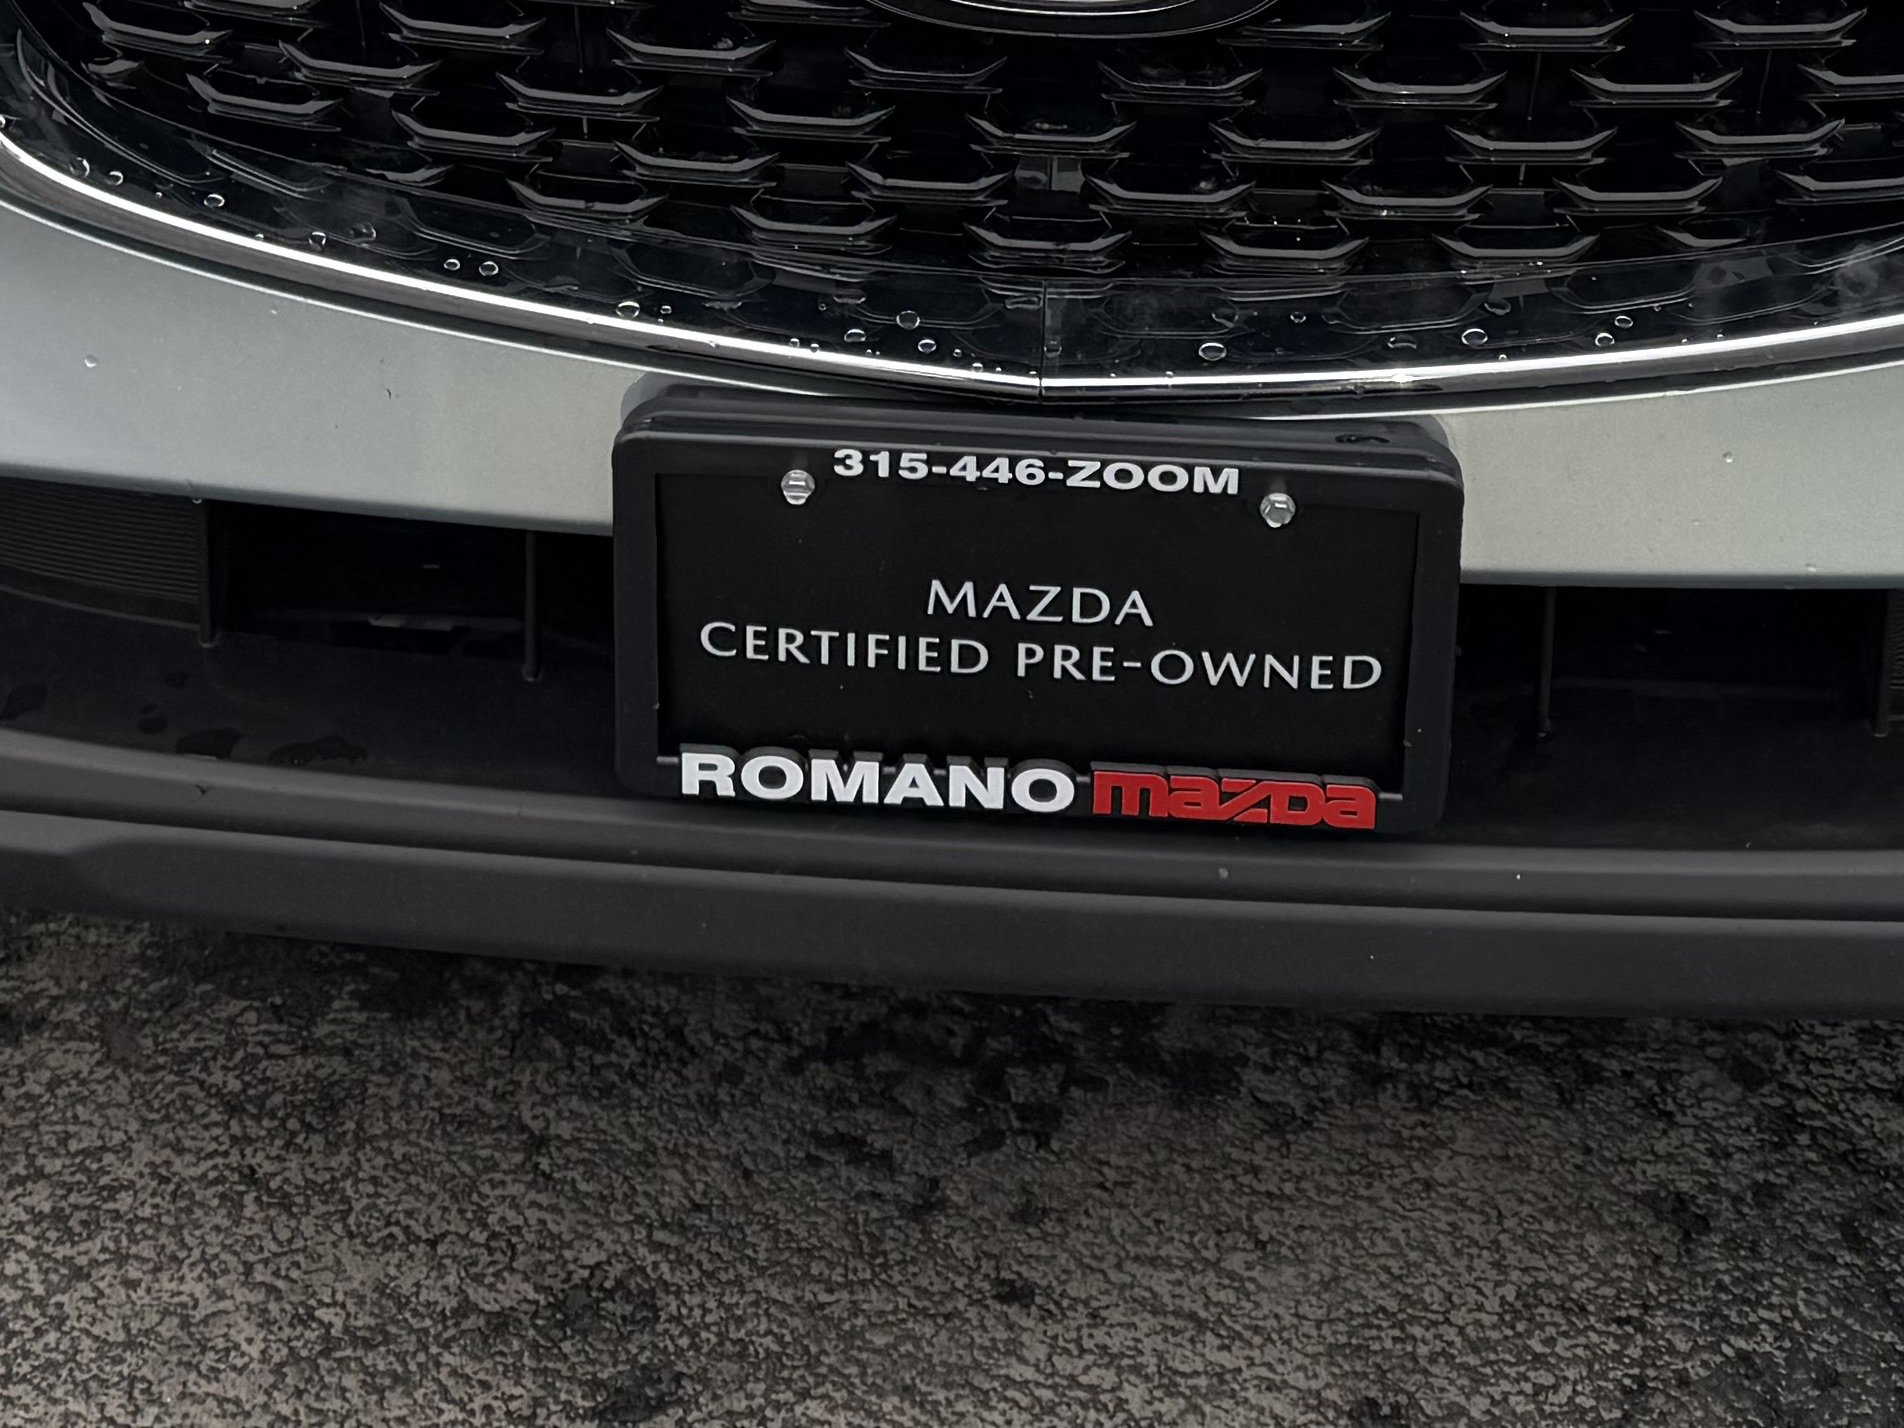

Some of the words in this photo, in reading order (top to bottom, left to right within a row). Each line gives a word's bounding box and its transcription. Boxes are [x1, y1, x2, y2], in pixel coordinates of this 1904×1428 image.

[833, 448, 1239, 495] 315-446-ZOOM
[927, 579, 1153, 626] MAZDA
[700, 621, 989, 675] CERTIFIED
[1017, 642, 1382, 690] PRE-OWNED
[681, 752, 1075, 813] ROMANO
